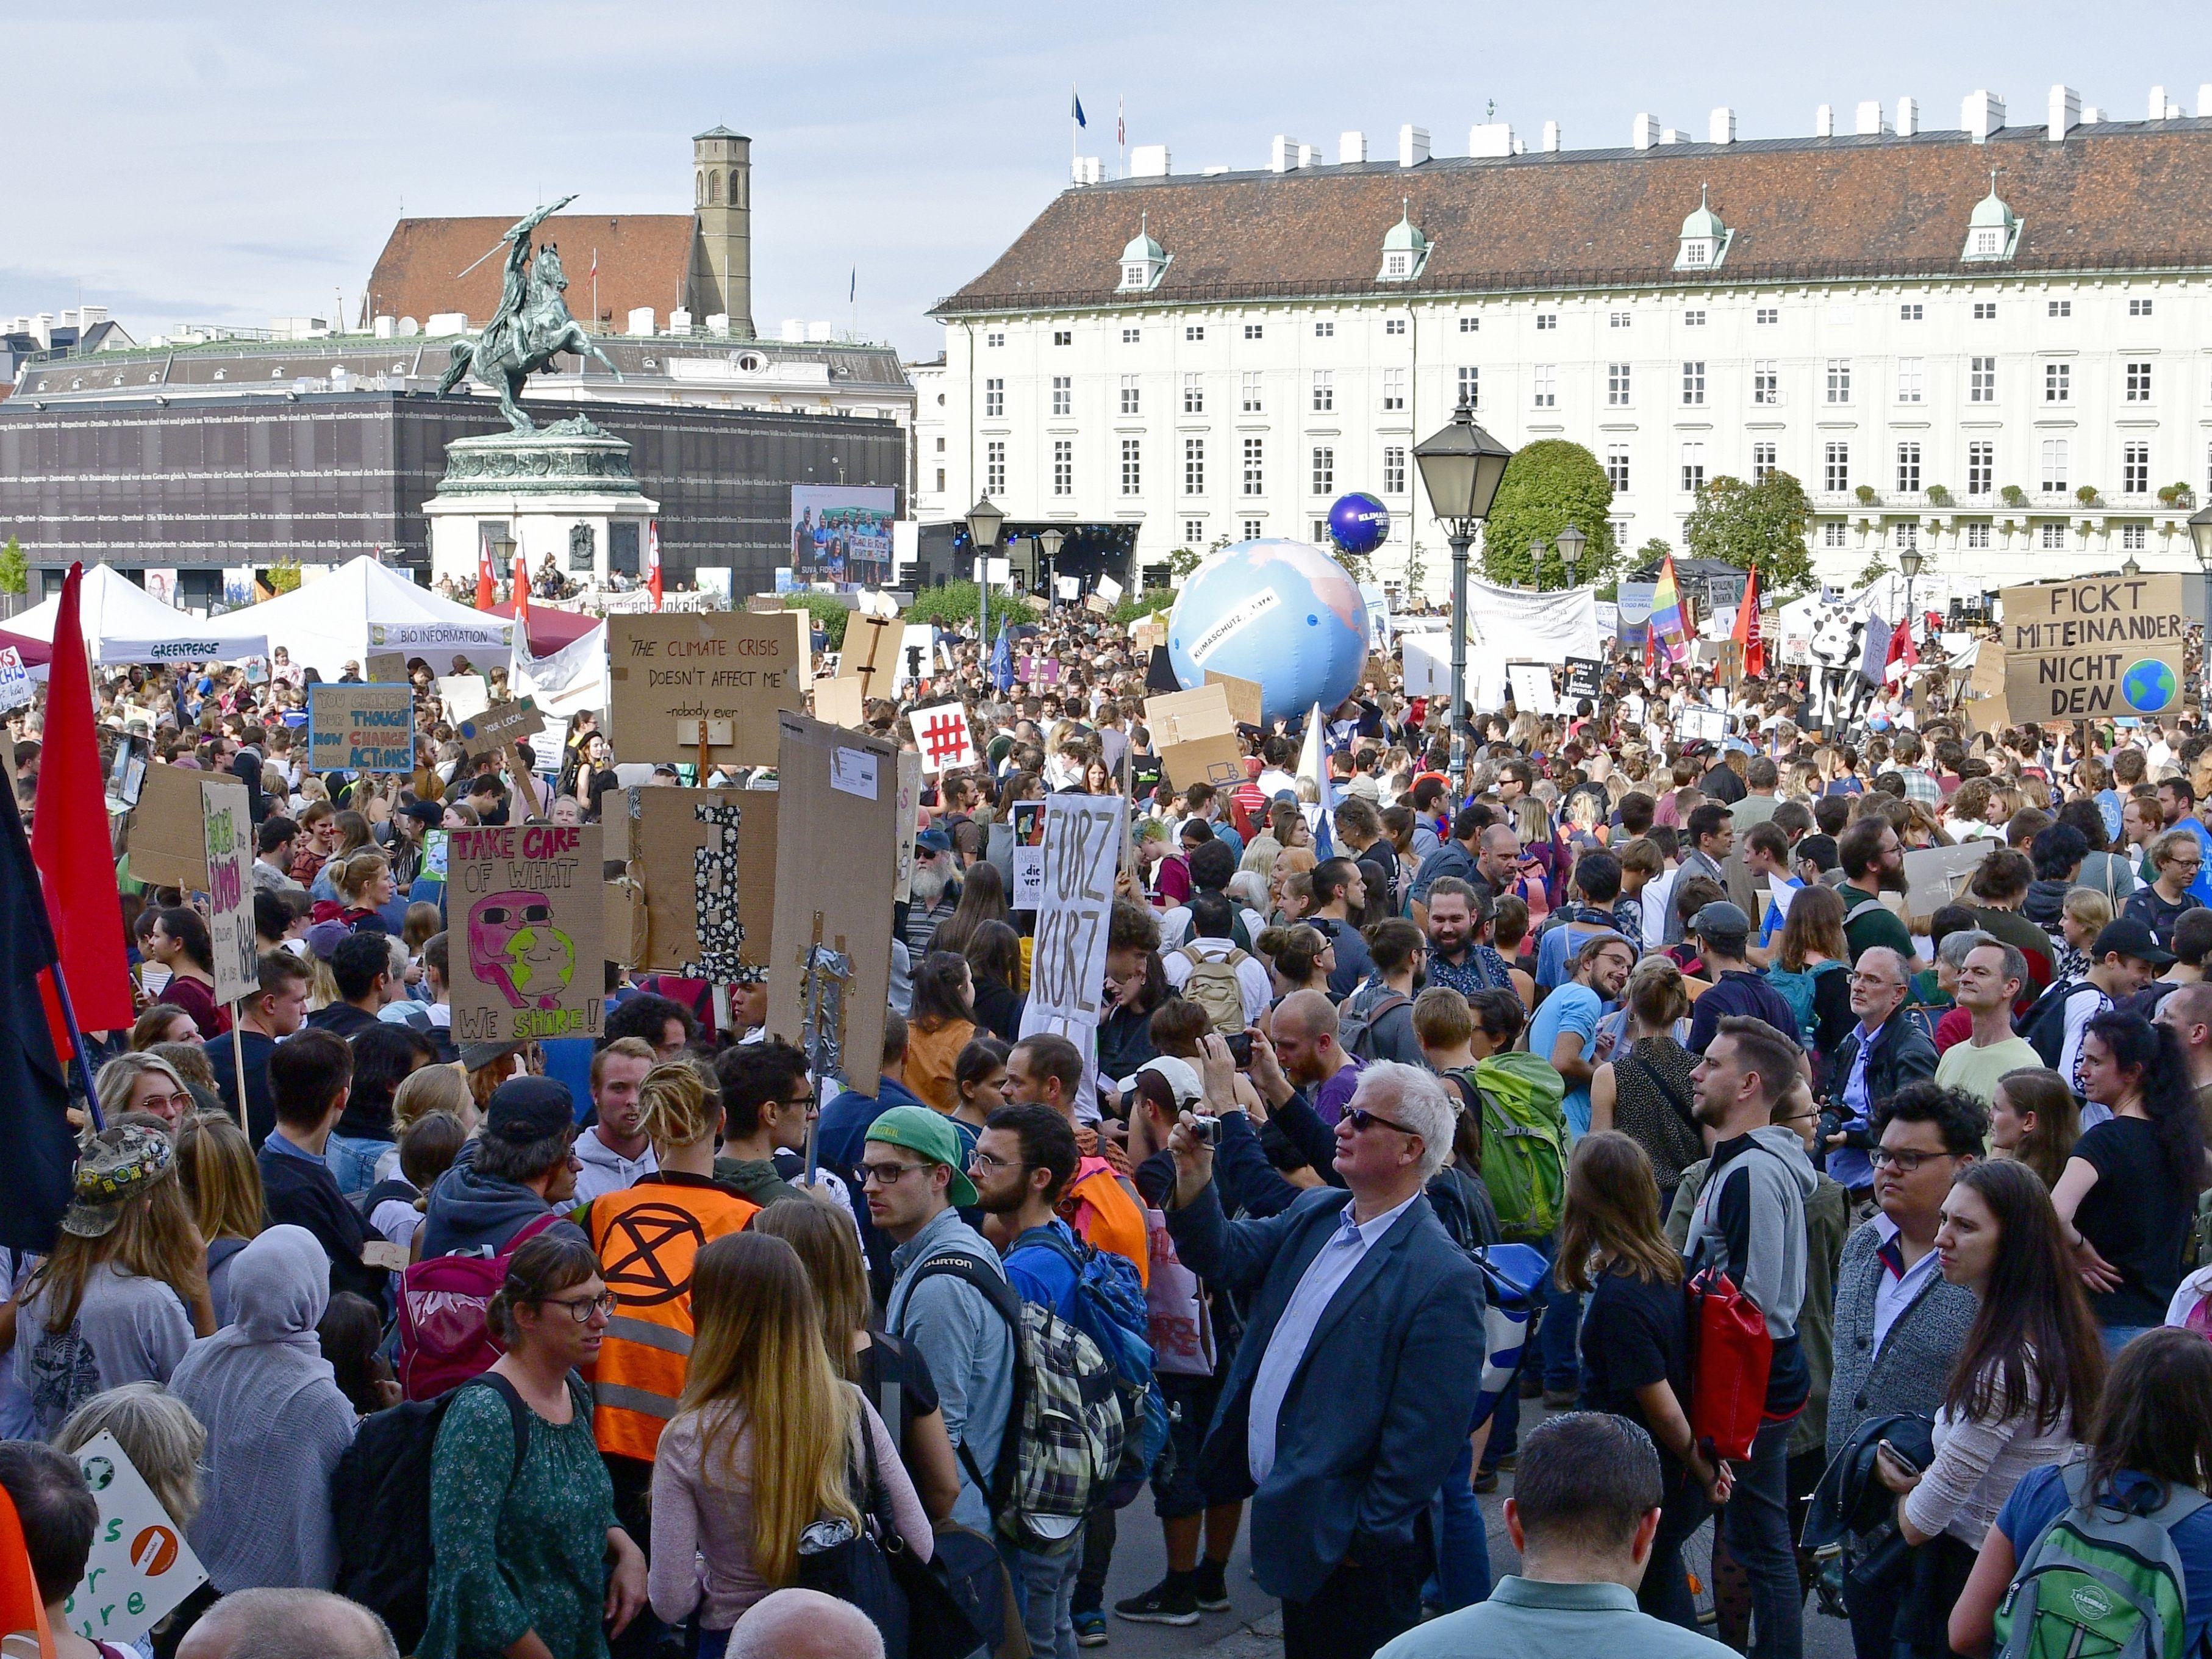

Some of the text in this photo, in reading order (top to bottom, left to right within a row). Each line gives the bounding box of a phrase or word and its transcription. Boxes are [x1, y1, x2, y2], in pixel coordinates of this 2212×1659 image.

[181, 418, 195, 426] gleich
[256, 415, 279, 424] geboren.
[374, 411, 393, 420] begabt
[327, 540, 340, 549] fähig
[2051, 581, 2147, 615] FICKT
[401, 629, 488, 642] BIO INFORMATION
[1194, 615, 1242, 659] KLIMASCHUTZ
[2016, 614, 2181, 650] MITEINANDER
[151, 642, 220, 659] GREENPEACE
[668, 640, 727, 656] CLIMATE
[738, 639, 779, 656] CRISIS
[650, 667, 706, 687] DOESN'T
[712, 671, 756, 687] AFFECT
[2039, 654, 2122, 684] NICHT
[318, 693, 411, 709] YOU CHANGED
[2052, 685, 2114, 715] DEN
[313, 709, 412, 726] YOUR THOUGHT
[714, 709, 738, 717] ever
[484, 722, 501, 734] YOUR
[501, 713, 525, 728] LOCAL
[313, 731, 409, 746] NOW CHANGE
[314, 754, 344, 768] YOUR
[452, 826, 580, 859] TAKE CARE
[1043, 809, 1115, 903] FURZ
[465, 858, 578, 892] OF WHAT
[1036, 909, 1100, 1012] KURZ
[460, 1007, 498, 1039] WE
[924, 1258, 973, 1269] BURTON
